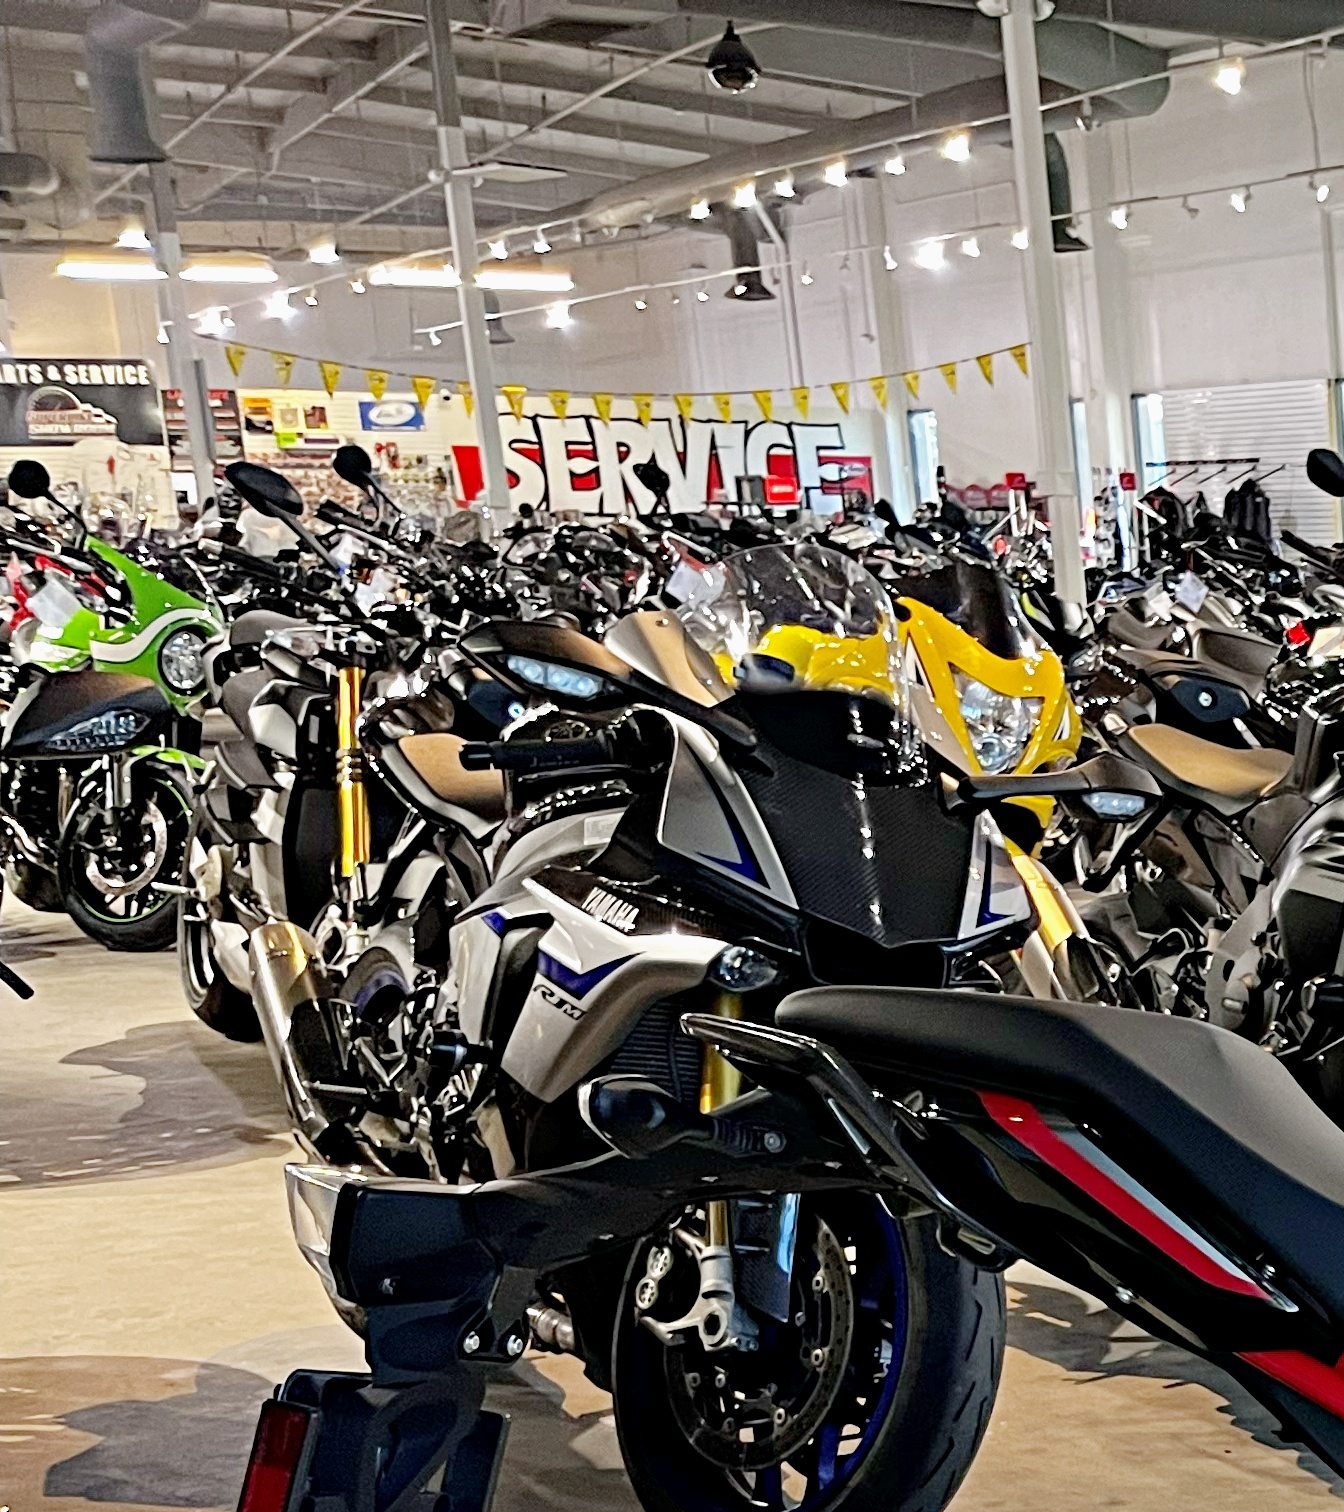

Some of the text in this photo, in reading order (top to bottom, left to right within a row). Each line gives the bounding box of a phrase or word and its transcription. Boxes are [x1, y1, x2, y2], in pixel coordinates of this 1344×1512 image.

[0, 363, 43, 384] RTS
[63, 364, 150, 385] SERVICE
[500, 413, 844, 516] SERVICE
[581, 886, 640, 932] YAMAHA
[533, 984, 588, 1021] R1M
